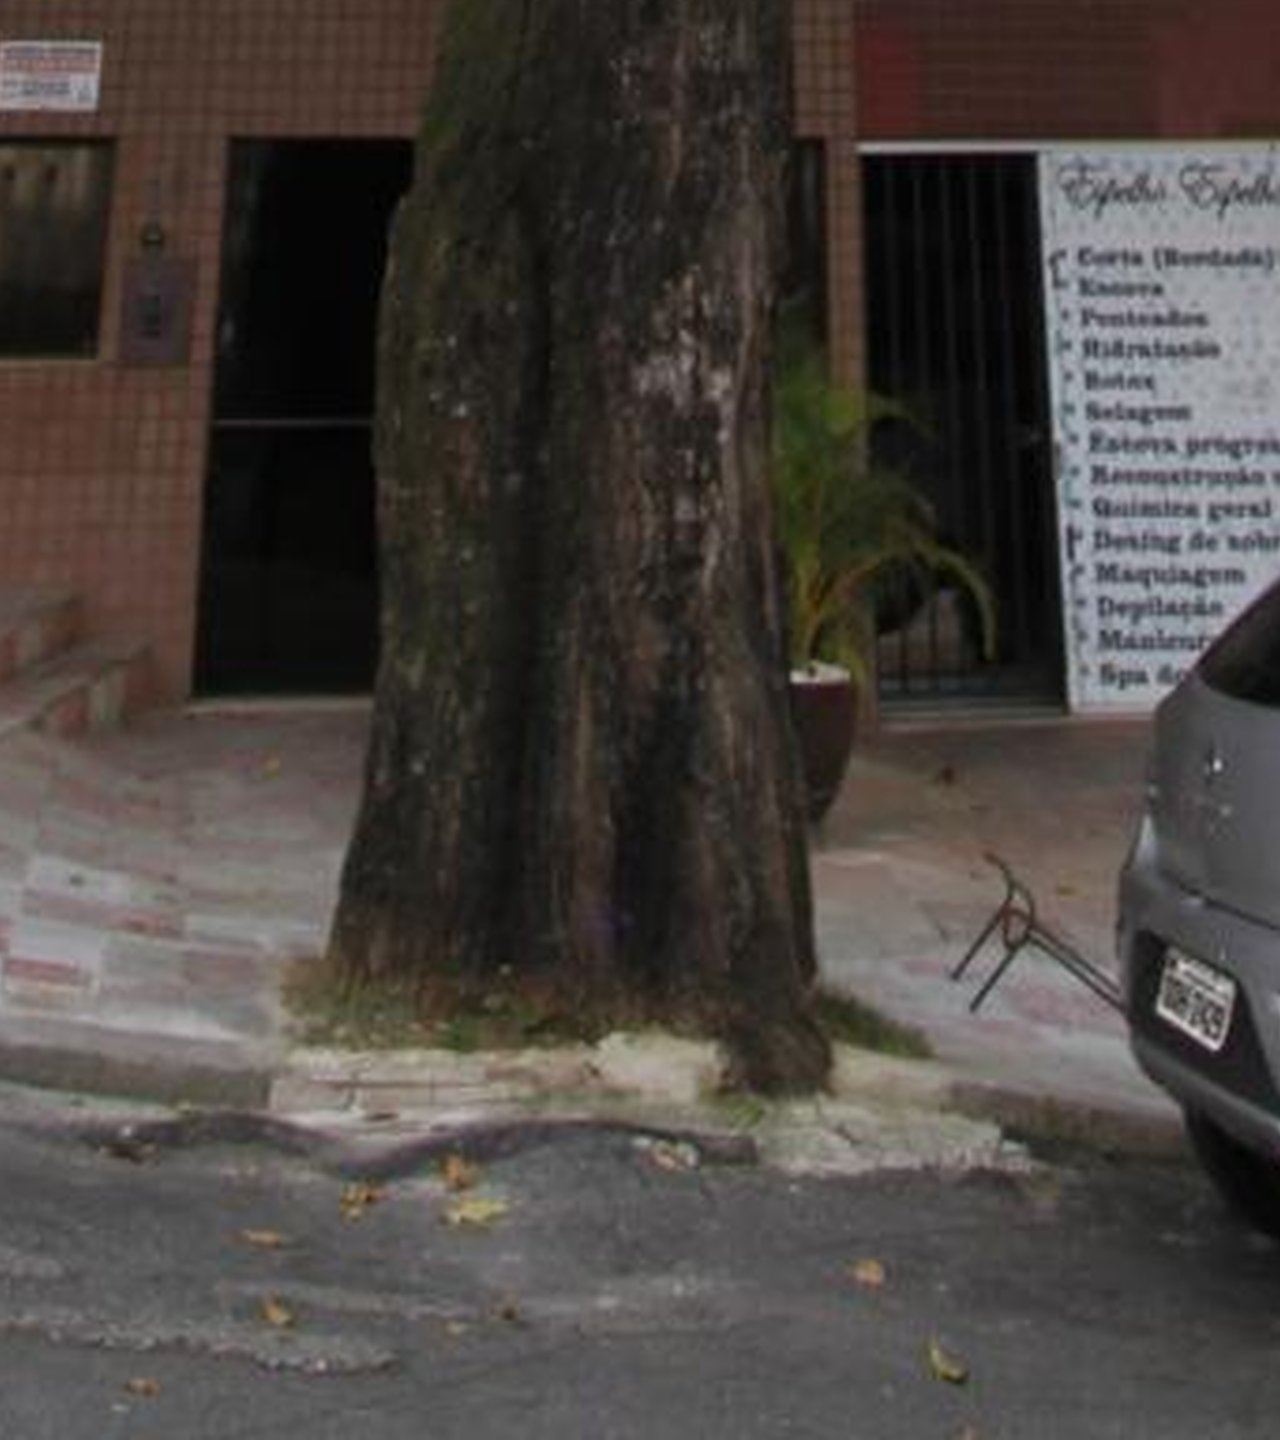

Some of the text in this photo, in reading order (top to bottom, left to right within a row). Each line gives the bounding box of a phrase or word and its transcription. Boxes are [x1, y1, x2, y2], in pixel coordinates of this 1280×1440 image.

[1081, 307, 1209, 328] Penteados
[1207, 499, 1272, 524] geral
[1188, 529, 1219, 552] de
[1096, 561, 1247, 588] Maquiagem
[1098, 628, 1206, 652] Manicur
